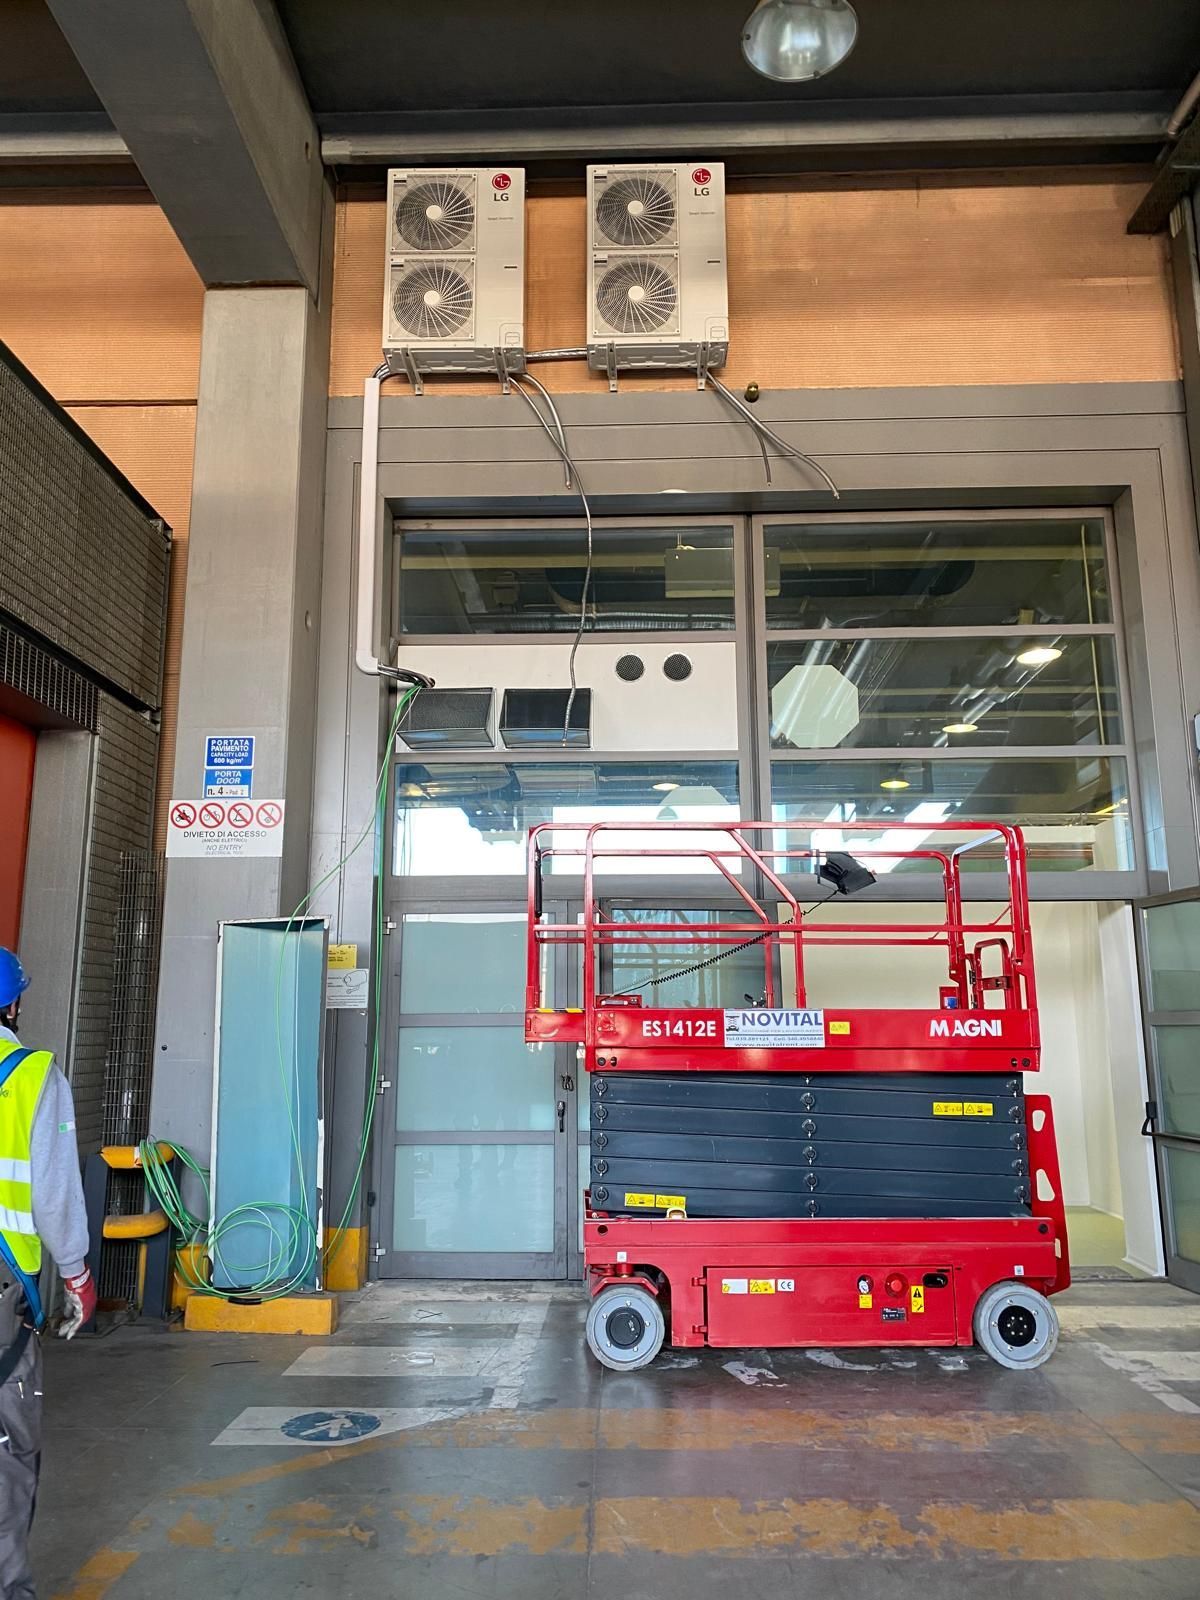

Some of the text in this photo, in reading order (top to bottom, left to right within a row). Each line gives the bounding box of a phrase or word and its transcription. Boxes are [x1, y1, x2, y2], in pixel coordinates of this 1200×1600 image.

[493, 192, 510, 202] LG
[694, 187, 710, 197] LG
[214, 770, 242, 778] PORTA
[216, 777, 241, 785] DOOR
[217, 786, 224, 796] 4
[183, 830, 267, 838] DIVIETO DI ACCESSO
[742, 1012, 823, 1026] NOVITAL
[642, 1020, 717, 1037] ES1412E
[929, 1019, 1003, 1037] MAGNI
